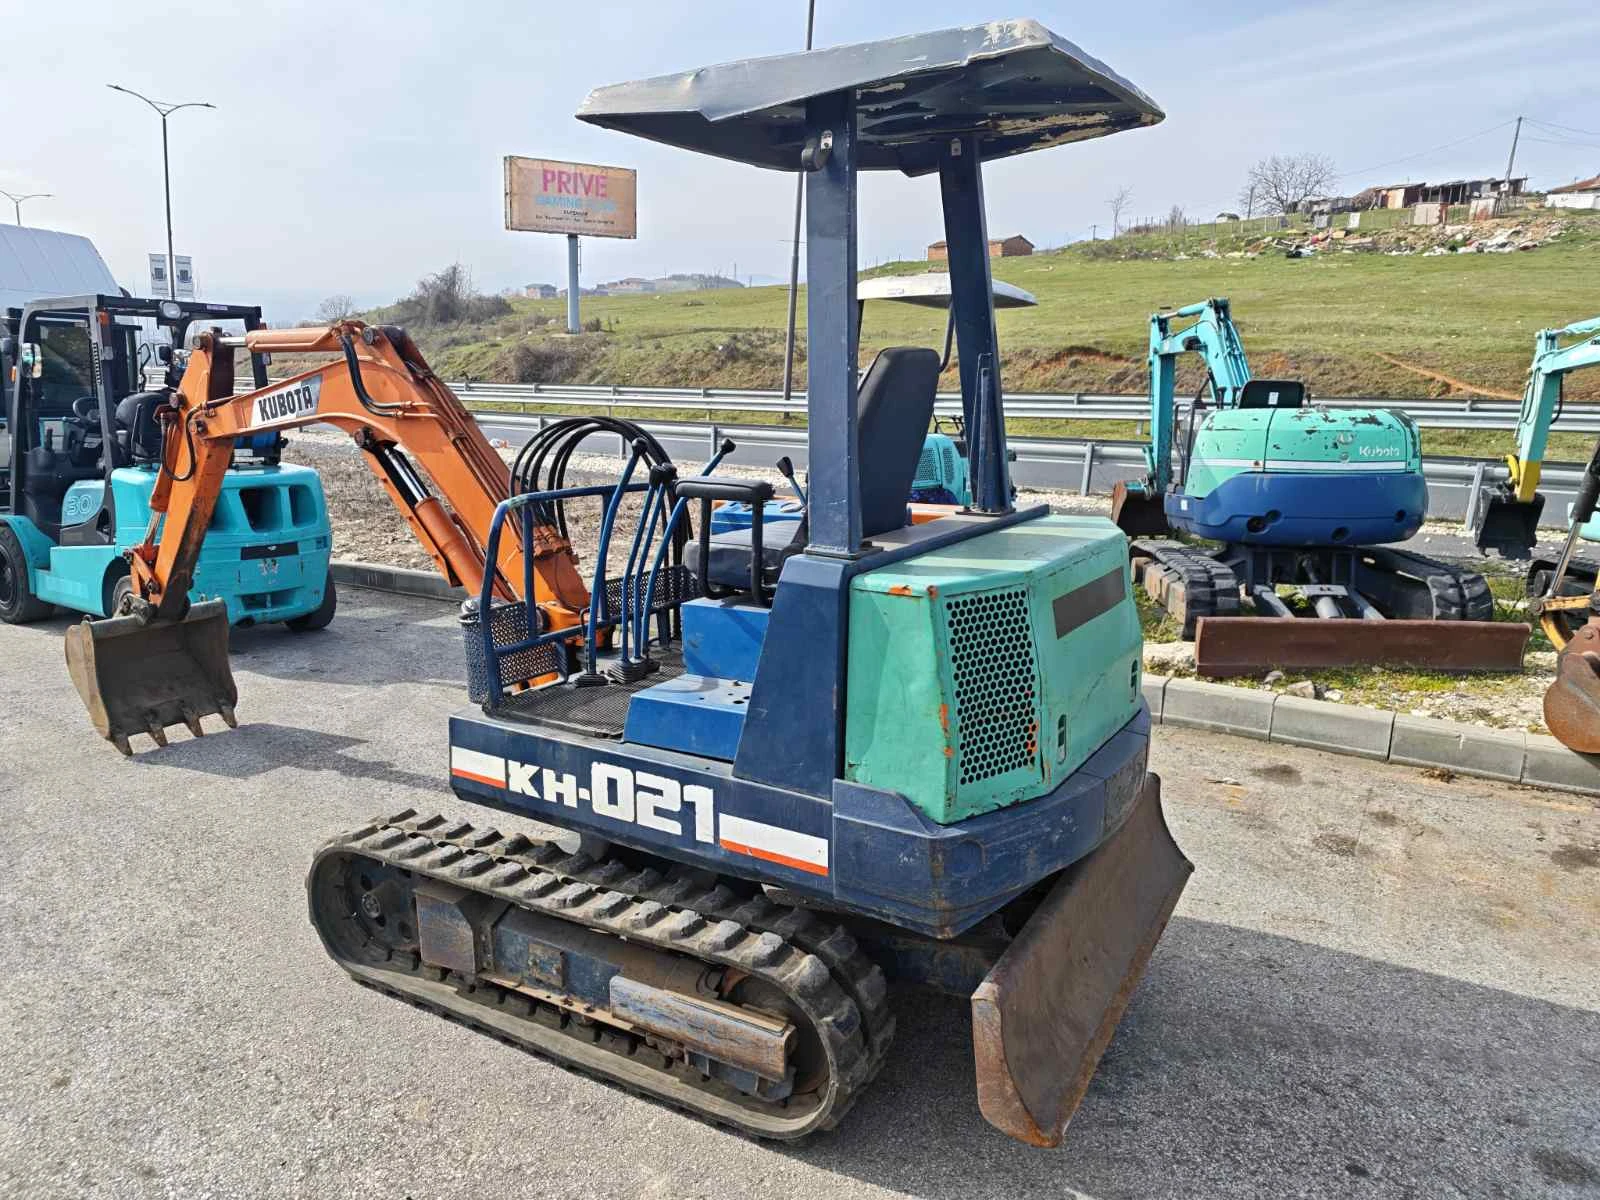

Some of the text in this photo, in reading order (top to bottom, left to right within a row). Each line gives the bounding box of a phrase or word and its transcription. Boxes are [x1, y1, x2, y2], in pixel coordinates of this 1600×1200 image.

[542, 168, 608, 197] PRIVE
[258, 385, 314, 422] KUBOTA
[1359, 446, 1400, 457] Kubota
[507, 759, 715, 845] KH-021
